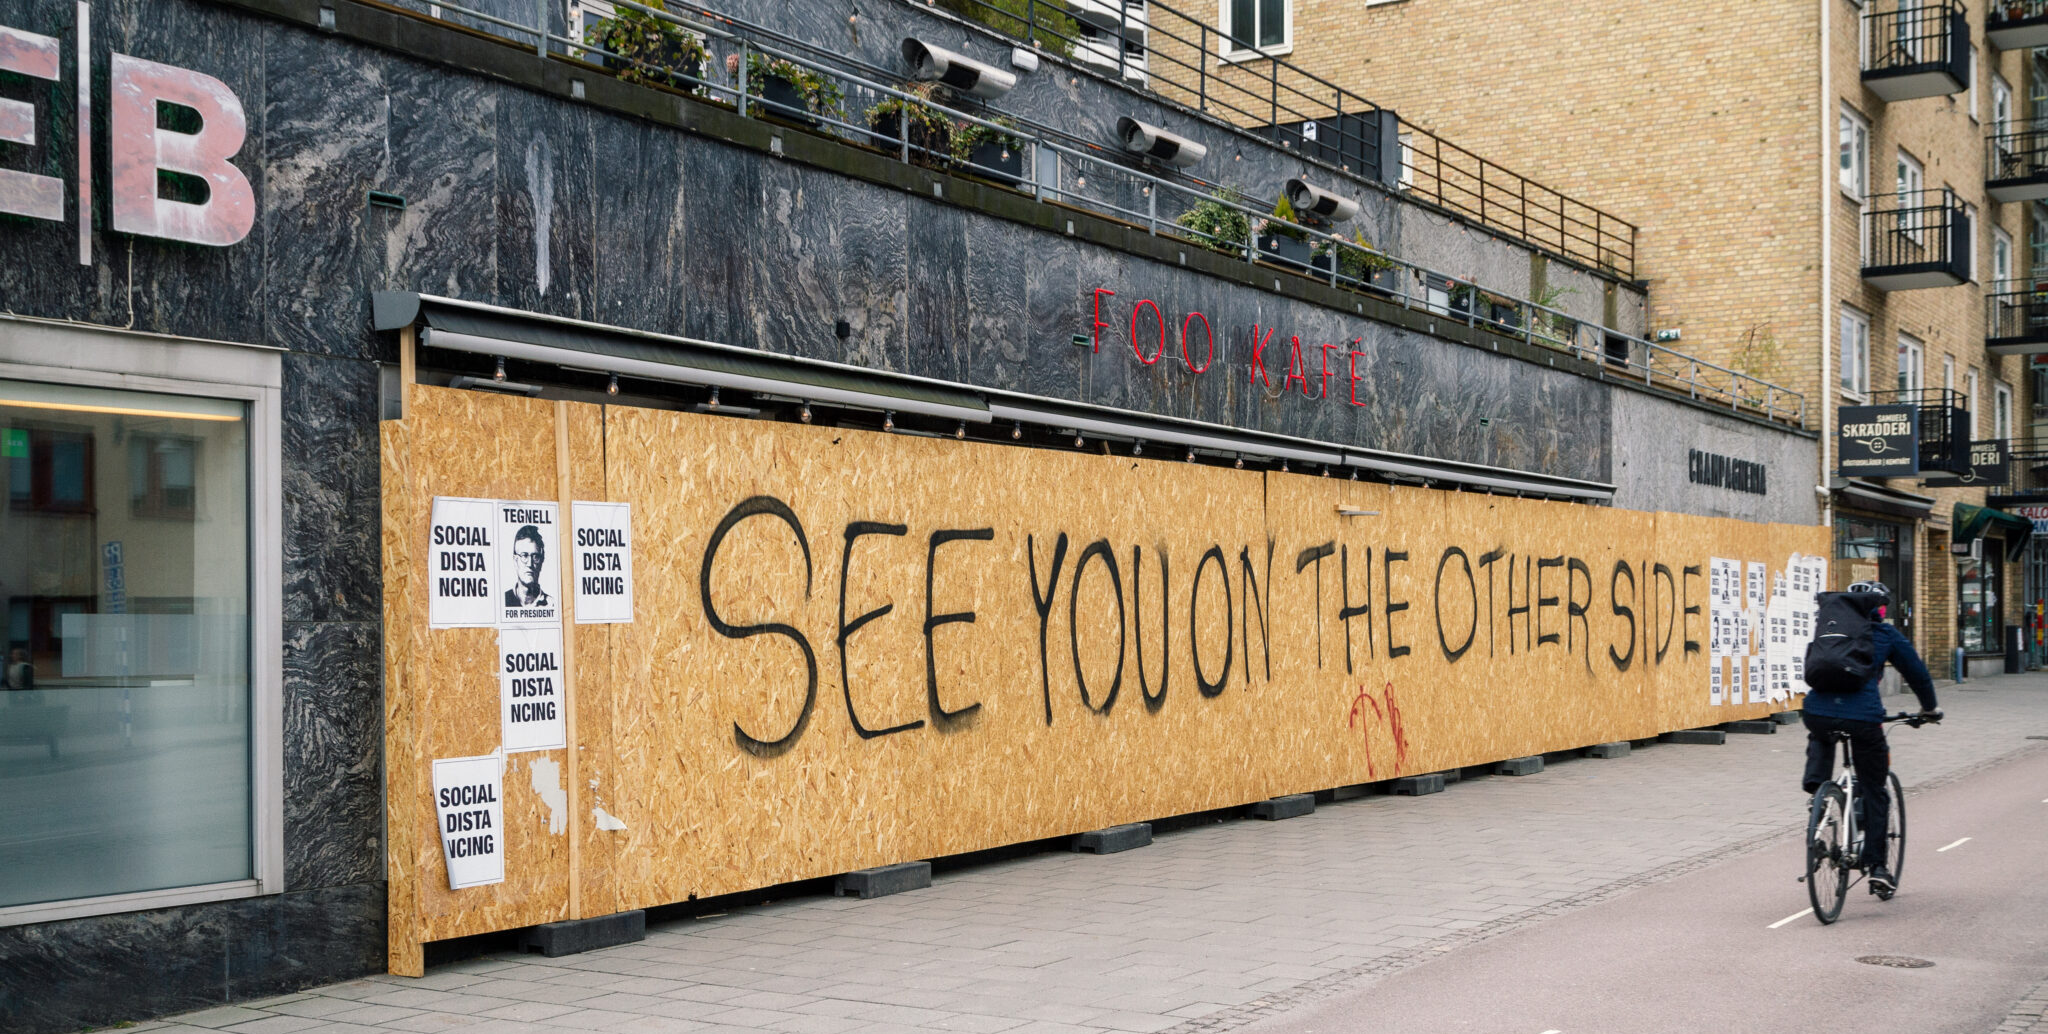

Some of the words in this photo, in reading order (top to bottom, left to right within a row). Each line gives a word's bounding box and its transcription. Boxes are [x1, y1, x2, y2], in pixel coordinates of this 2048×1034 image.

[1094, 288, 1213, 374] FOO
[1876, 413, 1908, 423] SAMUELS
[1842, 421, 1911, 437] SKRÄDDERI
[503, 508, 552, 525] TEGNELL
[434, 525, 490, 548] SOCIAL
[577, 528, 625, 548] SOCIAL
[440, 551, 486, 572] DISTA
[583, 552, 622, 571] DISTA
[438, 577, 488, 597] NCING
[582, 576, 624, 596] NCING
[505, 609, 518, 619] FOR
[519, 608, 554, 619] PRESIDENT
[700, 495, 994, 758] SEE
[1027, 531, 1169, 726] YOU
[1190, 533, 1275, 698] ON
[1296, 540, 1411, 675] THE
[1434, 545, 1596, 678] OTHER
[1609, 559, 1702, 673] SIDE
[505, 652, 558, 673] SOCIAL
[512, 677, 554, 697] DISTA
[511, 702, 556, 723] NCING
[439, 783, 497, 808] SOCIAL
[446, 810, 491, 834] DISTA
